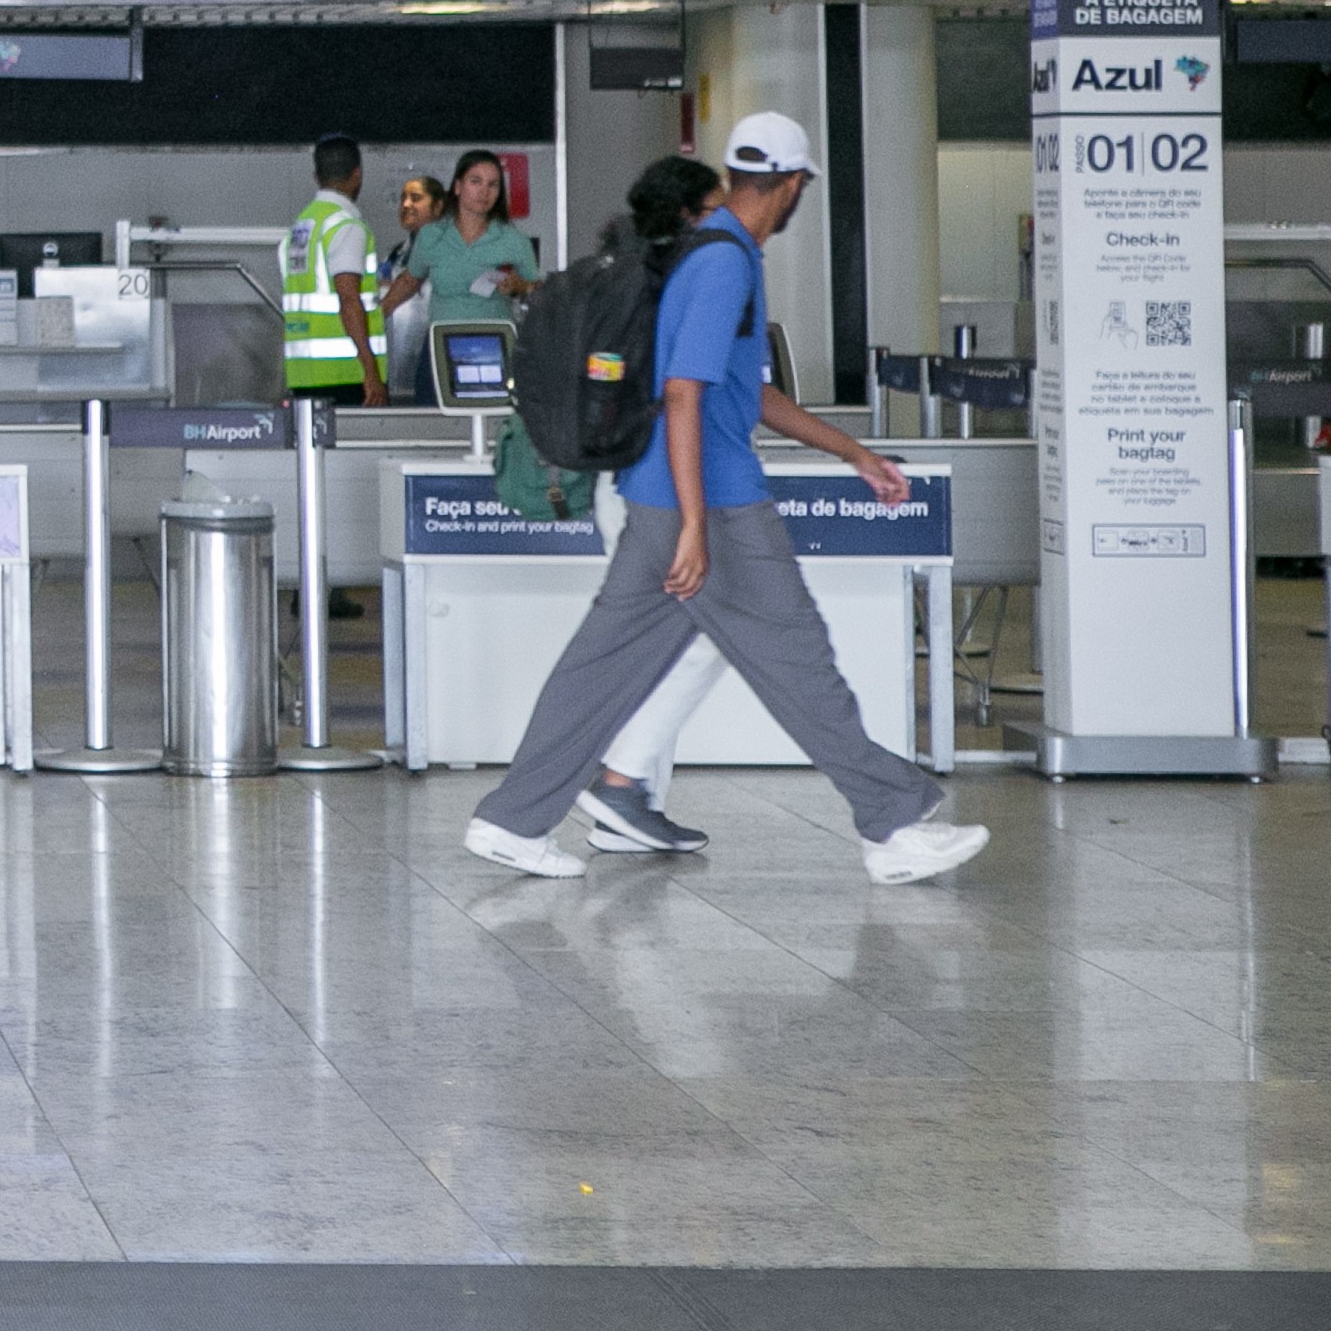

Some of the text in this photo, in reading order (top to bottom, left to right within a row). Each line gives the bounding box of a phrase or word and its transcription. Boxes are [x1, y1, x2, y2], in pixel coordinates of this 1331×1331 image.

[1076, 8, 1203, 25] DE BAGAGEM
[1072, 59, 1163, 91] Azul
[1087, 135, 1134, 172] 01
[1151, 133, 1209, 172] 02
[1106, 232, 1180, 246] Check-in
[119, 274, 148, 295] 20
[184, 424, 261, 442] BHAirport
[1108, 428, 1186, 446] Print your
[1119, 446, 1175, 463] bagtag
[425, 497, 471, 519] Faça
[475, 501, 508, 516] seu
[811, 498, 835, 517] de
[839, 498, 928, 520] bagagem
[425, 520, 594, 535] Check-in and print your bagtag
